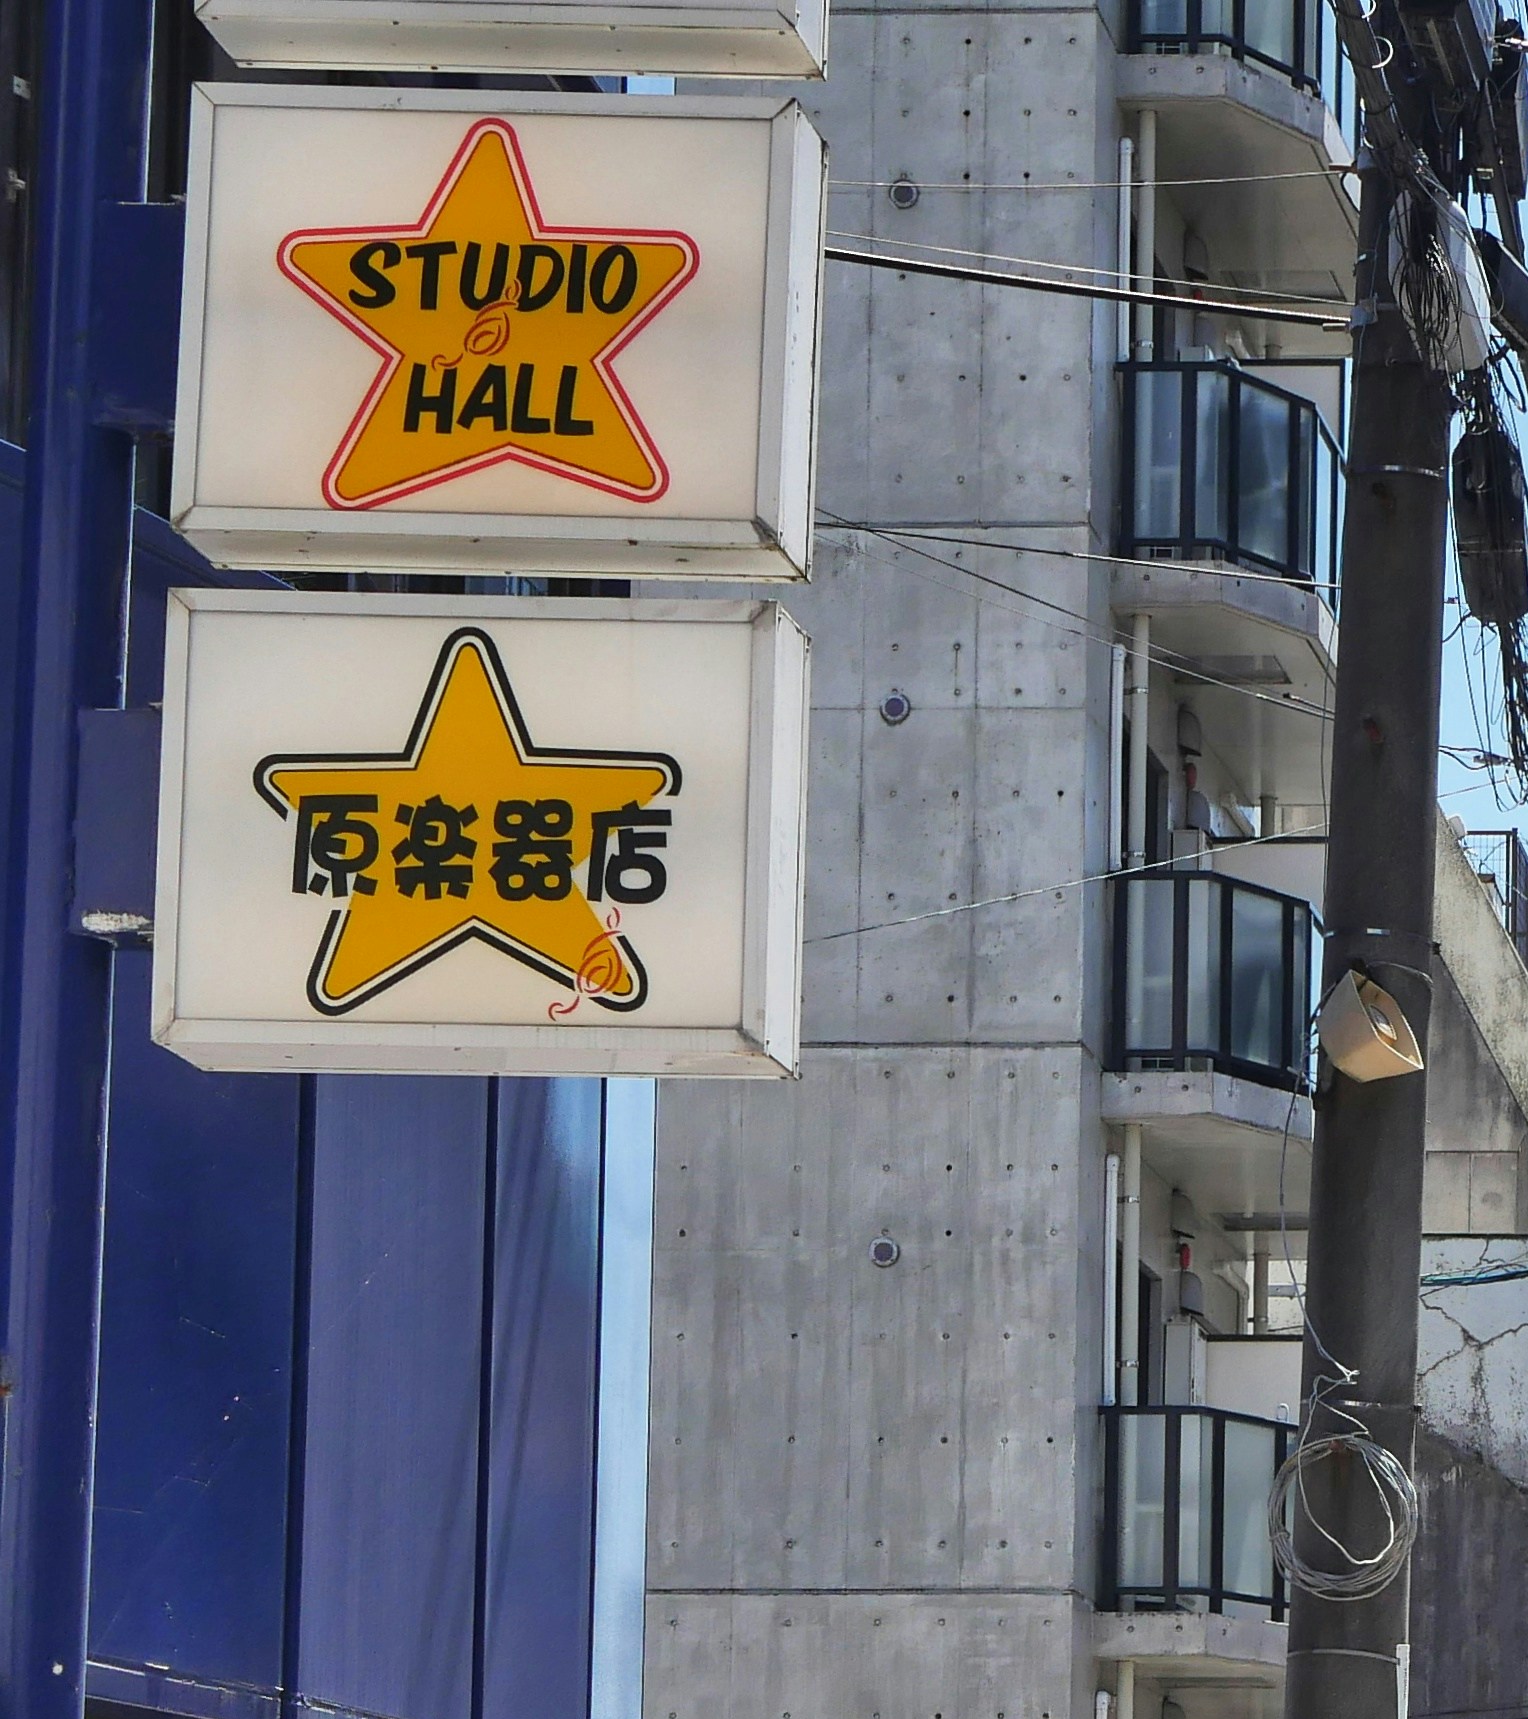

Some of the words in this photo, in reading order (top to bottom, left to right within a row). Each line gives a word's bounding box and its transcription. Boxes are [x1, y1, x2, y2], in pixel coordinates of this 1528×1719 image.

[348, 240, 638, 315] STUDIO
[402, 362, 594, 437] HALL
[292, 793, 672, 907] 原楽器店
